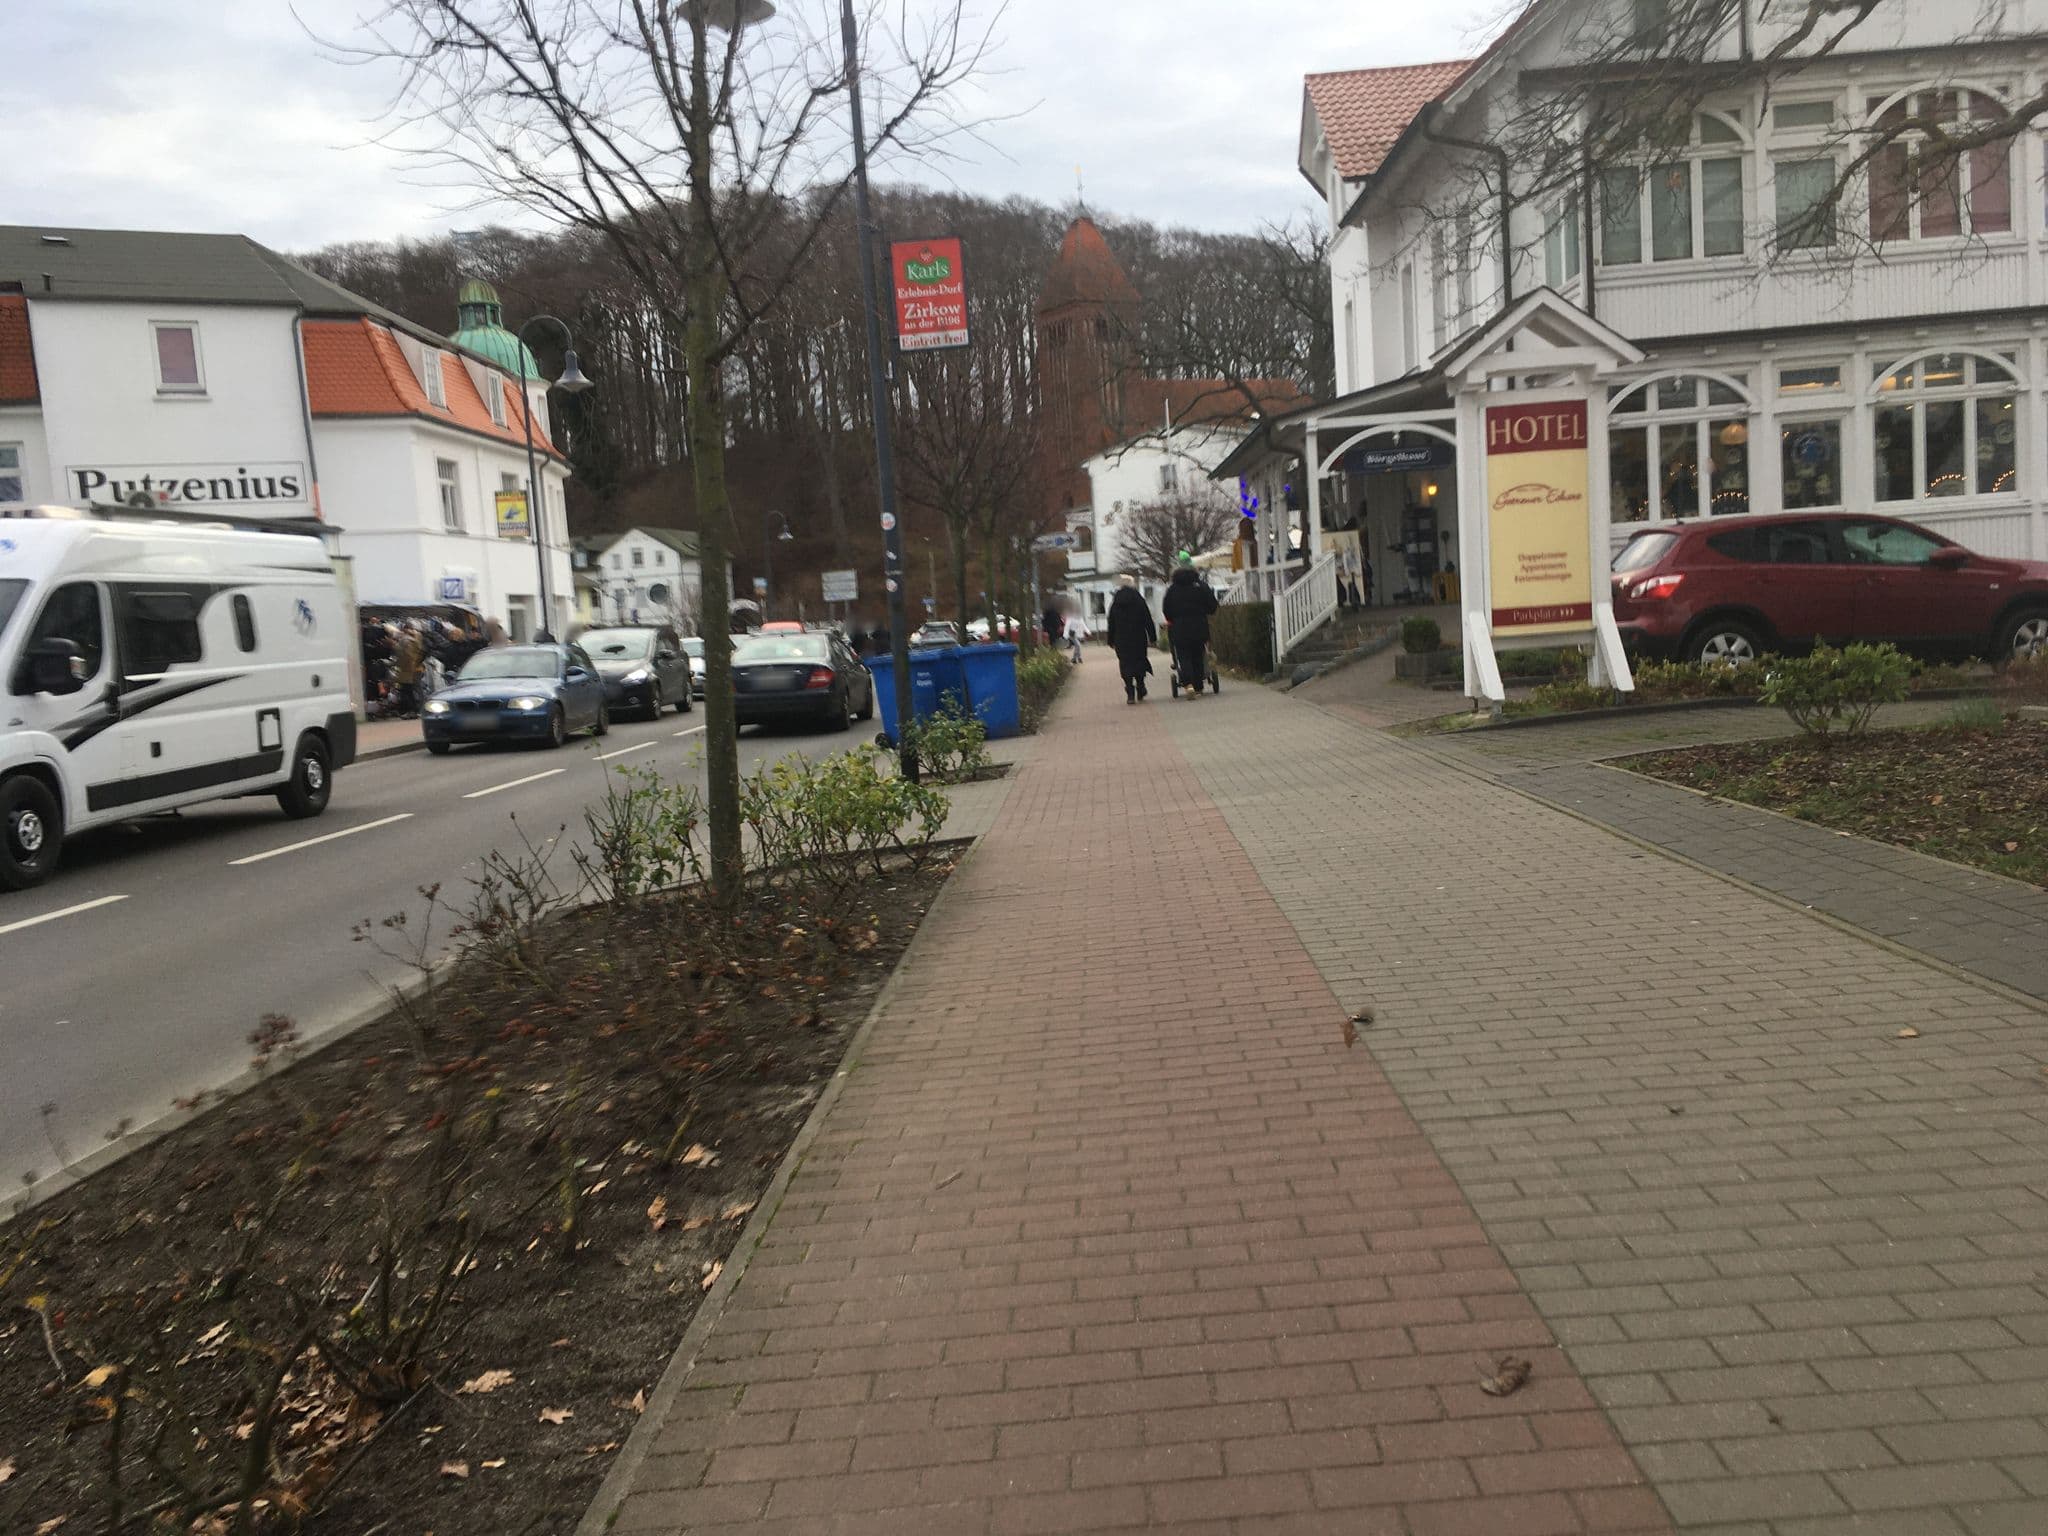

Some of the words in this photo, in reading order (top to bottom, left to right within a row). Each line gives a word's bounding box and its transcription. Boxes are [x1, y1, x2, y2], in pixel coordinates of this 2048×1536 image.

[907, 261, 949, 280] Karls
[897, 282, 962, 299] Erlebnis-Dorf
[904, 301, 961, 319] Zirkow
[904, 321, 916, 329] an
[919, 318, 934, 329] der
[902, 333, 941, 348] Eintritt
[1490, 413, 1585, 446] HOTEL
[72, 467, 301, 503] Putzenius
